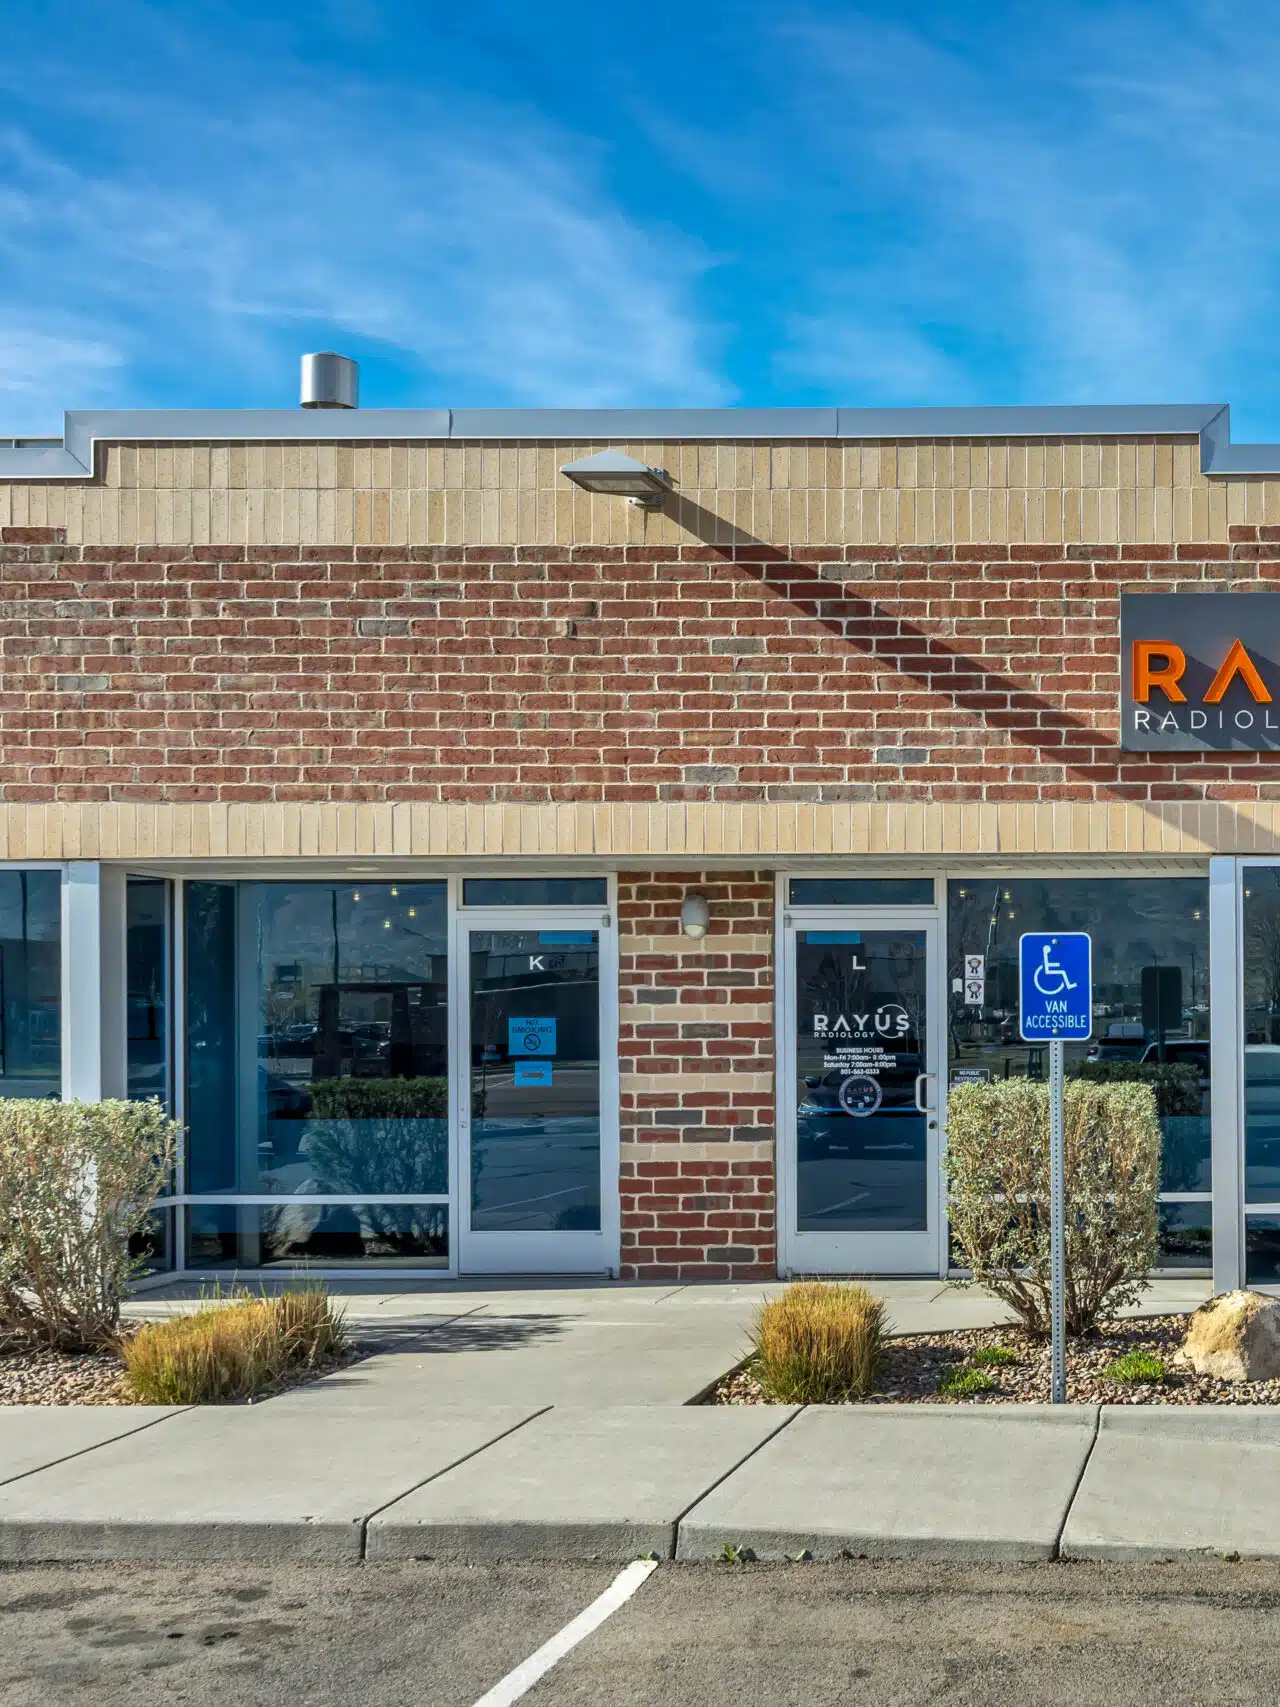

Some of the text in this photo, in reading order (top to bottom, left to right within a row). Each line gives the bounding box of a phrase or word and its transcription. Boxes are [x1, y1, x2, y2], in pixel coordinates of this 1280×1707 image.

[529, 956, 544, 971] K
[853, 956, 866, 970] L
[1045, 1000, 1067, 1013] VAN
[814, 1014, 910, 1031] RAYUS
[1026, 1015, 1087, 1028] ACCESSIBLE
